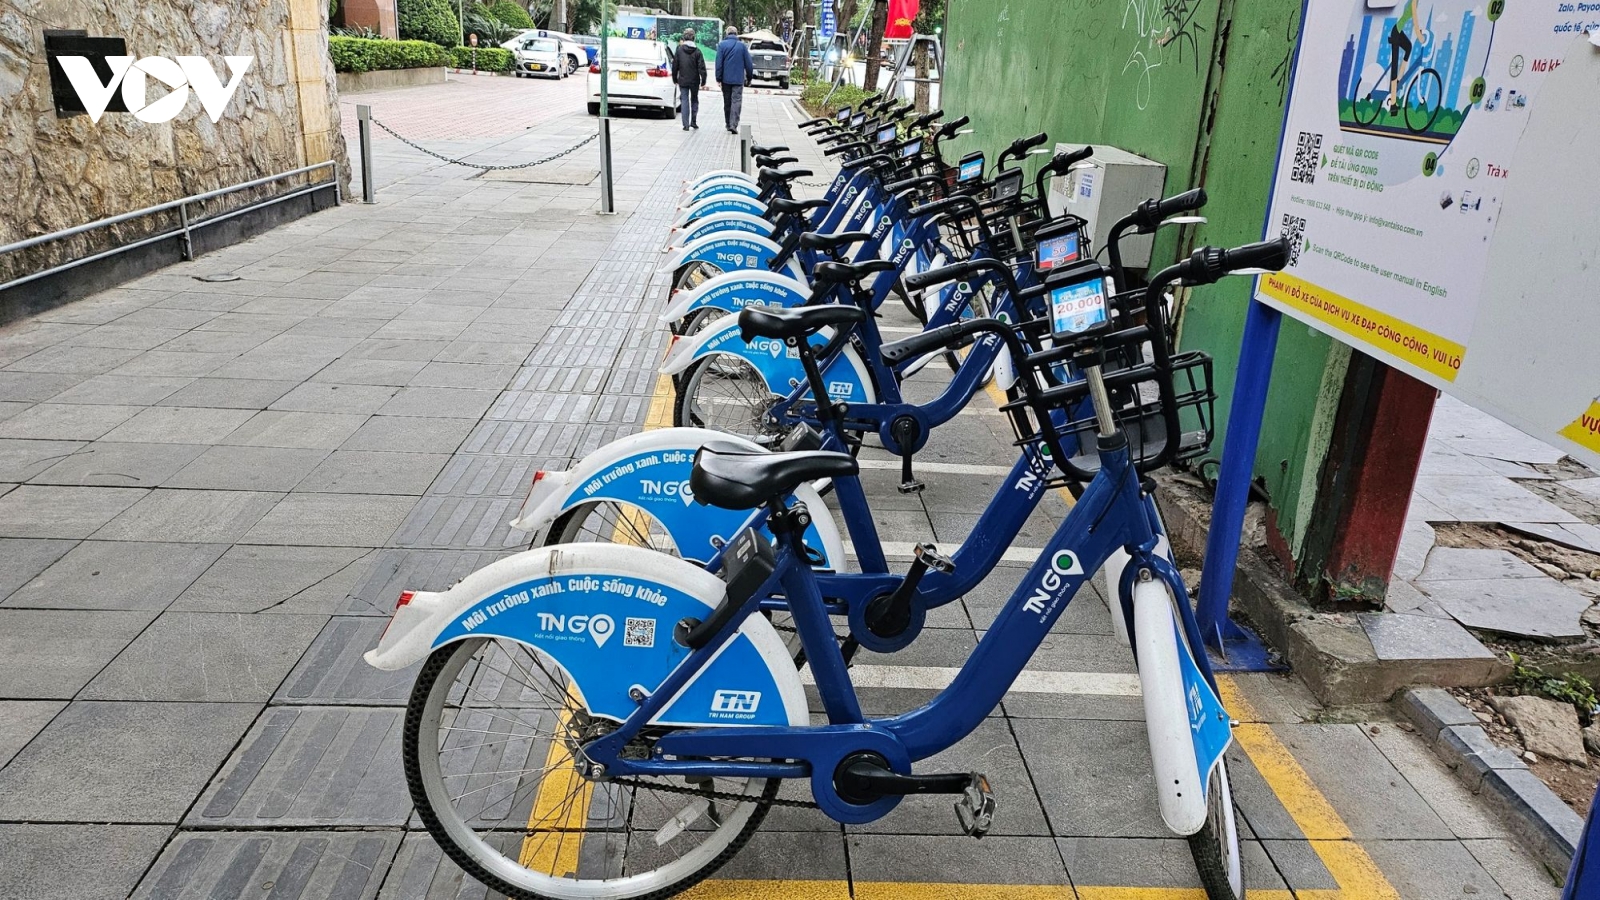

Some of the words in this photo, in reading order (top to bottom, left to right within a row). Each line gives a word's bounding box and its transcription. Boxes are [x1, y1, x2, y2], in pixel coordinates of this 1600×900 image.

[1490, 1, 1501, 14] 02
[1558, 3, 1575, 13] Zalo,
[1473, 84, 1483, 97] 03
[1364, 150, 1379, 159] CODE
[1425, 158, 1435, 171] 04
[872, 215, 892, 239] TNGO
[892, 238, 915, 264] TNGO
[1312, 244, 1324, 255] Scan
[1324, 248, 1332, 257] the
[1333, 250, 1353, 265] QRCode
[1354, 258, 1359, 267] to
[1360, 261, 1370, 271] see
[1370, 264, 1379, 274] the
[1380, 268, 1393, 278] user
[1393, 273, 1415, 286] manual
[1415, 277, 1422, 288] in
[1423, 282, 1447, 298] English
[944, 281, 973, 312] TNGO
[1057, 295, 1102, 314] 20.000
[1269, 277, 1284, 291] PHẠM
[1285, 284, 1291, 294] VI
[1301, 292, 1309, 302] XE
[1310, 294, 1322, 308] CỦA
[1323, 302, 1340, 316] DỊCH
[1341, 308, 1350, 323] VỤ
[1351, 313, 1361, 325] XE
[1361, 318, 1376, 333] ĐẠP
[1377, 325, 1401, 343] CÔNG
[1403, 336, 1429, 359] CỘNG,
[1433, 348, 1447, 364] VUI
[583, 478, 604, 496] Môi
[602, 463, 635, 484] trường
[635, 455, 661, 470] xanh.
[663, 450, 687, 465] Cuộc
[1023, 549, 1084, 614] TNGO
[461, 609, 488, 632] Môi
[486, 590, 530, 617] trường
[530, 581, 565, 599] xanh.
[568, 576, 600, 594] Cuộc
[602, 578, 635, 598] sống
[635, 585, 668, 607] khỏe
[536, 612, 615, 649] TNGO
[716, 692, 758, 711] TN
